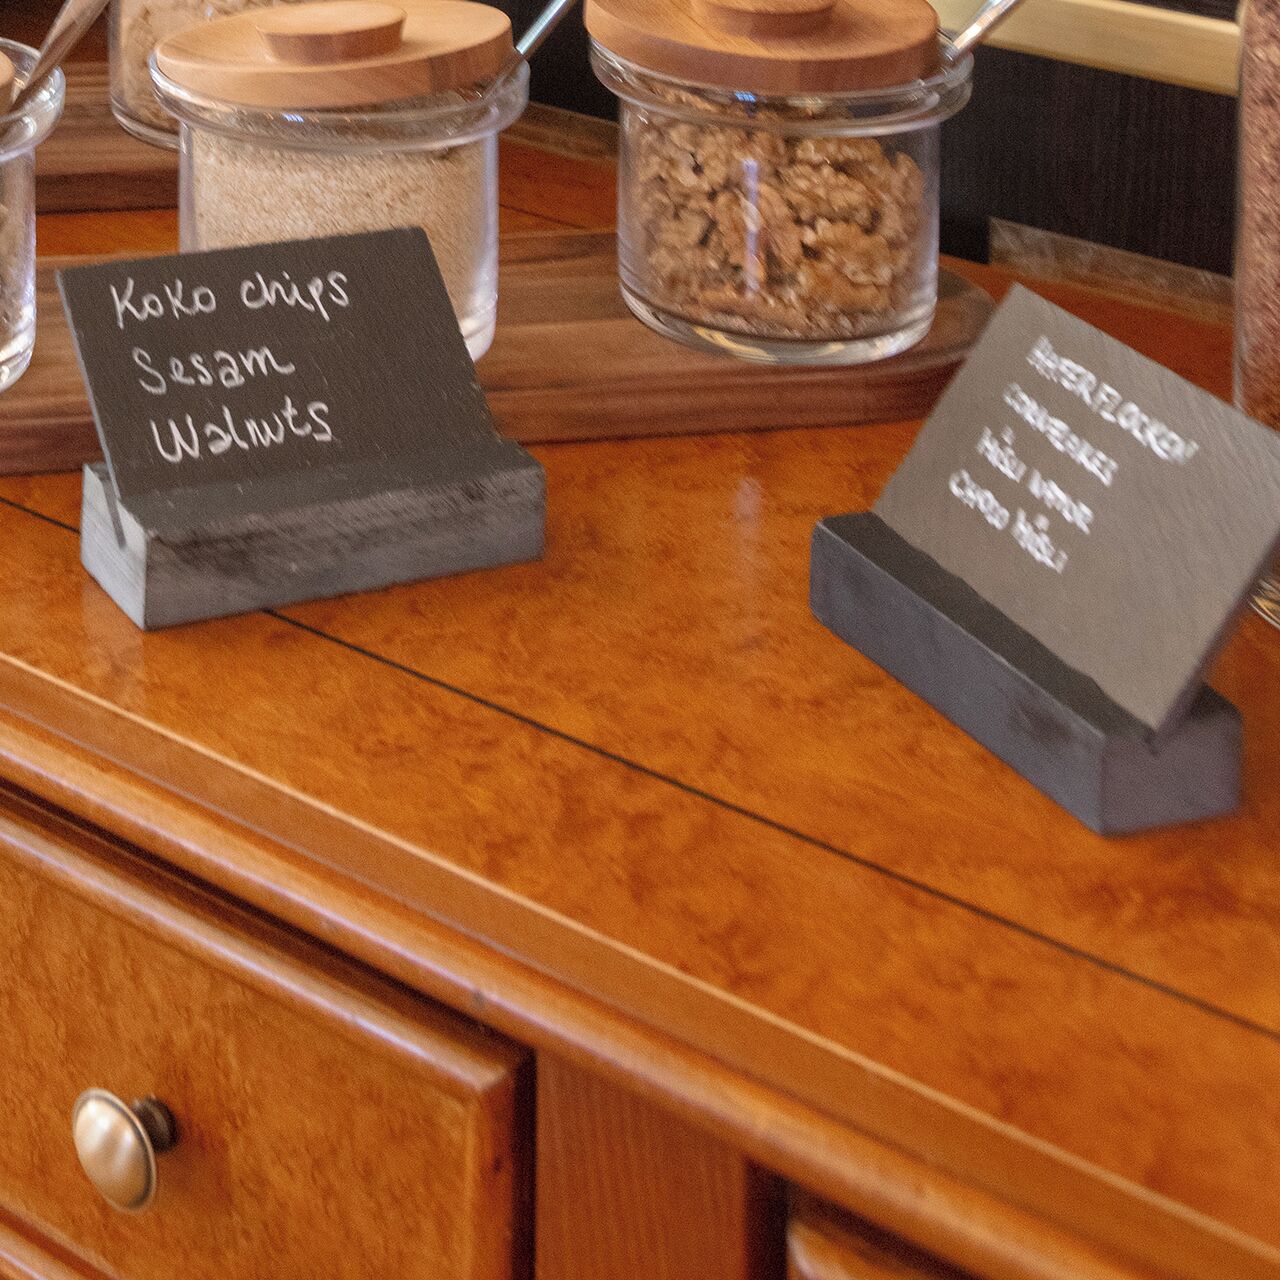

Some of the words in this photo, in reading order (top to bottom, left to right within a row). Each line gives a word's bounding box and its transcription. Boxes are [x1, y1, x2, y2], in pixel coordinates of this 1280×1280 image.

[240, 269, 351, 322] chips
[132, 344, 296, 395] Sesam
[150, 395, 333, 463] Walnuts
